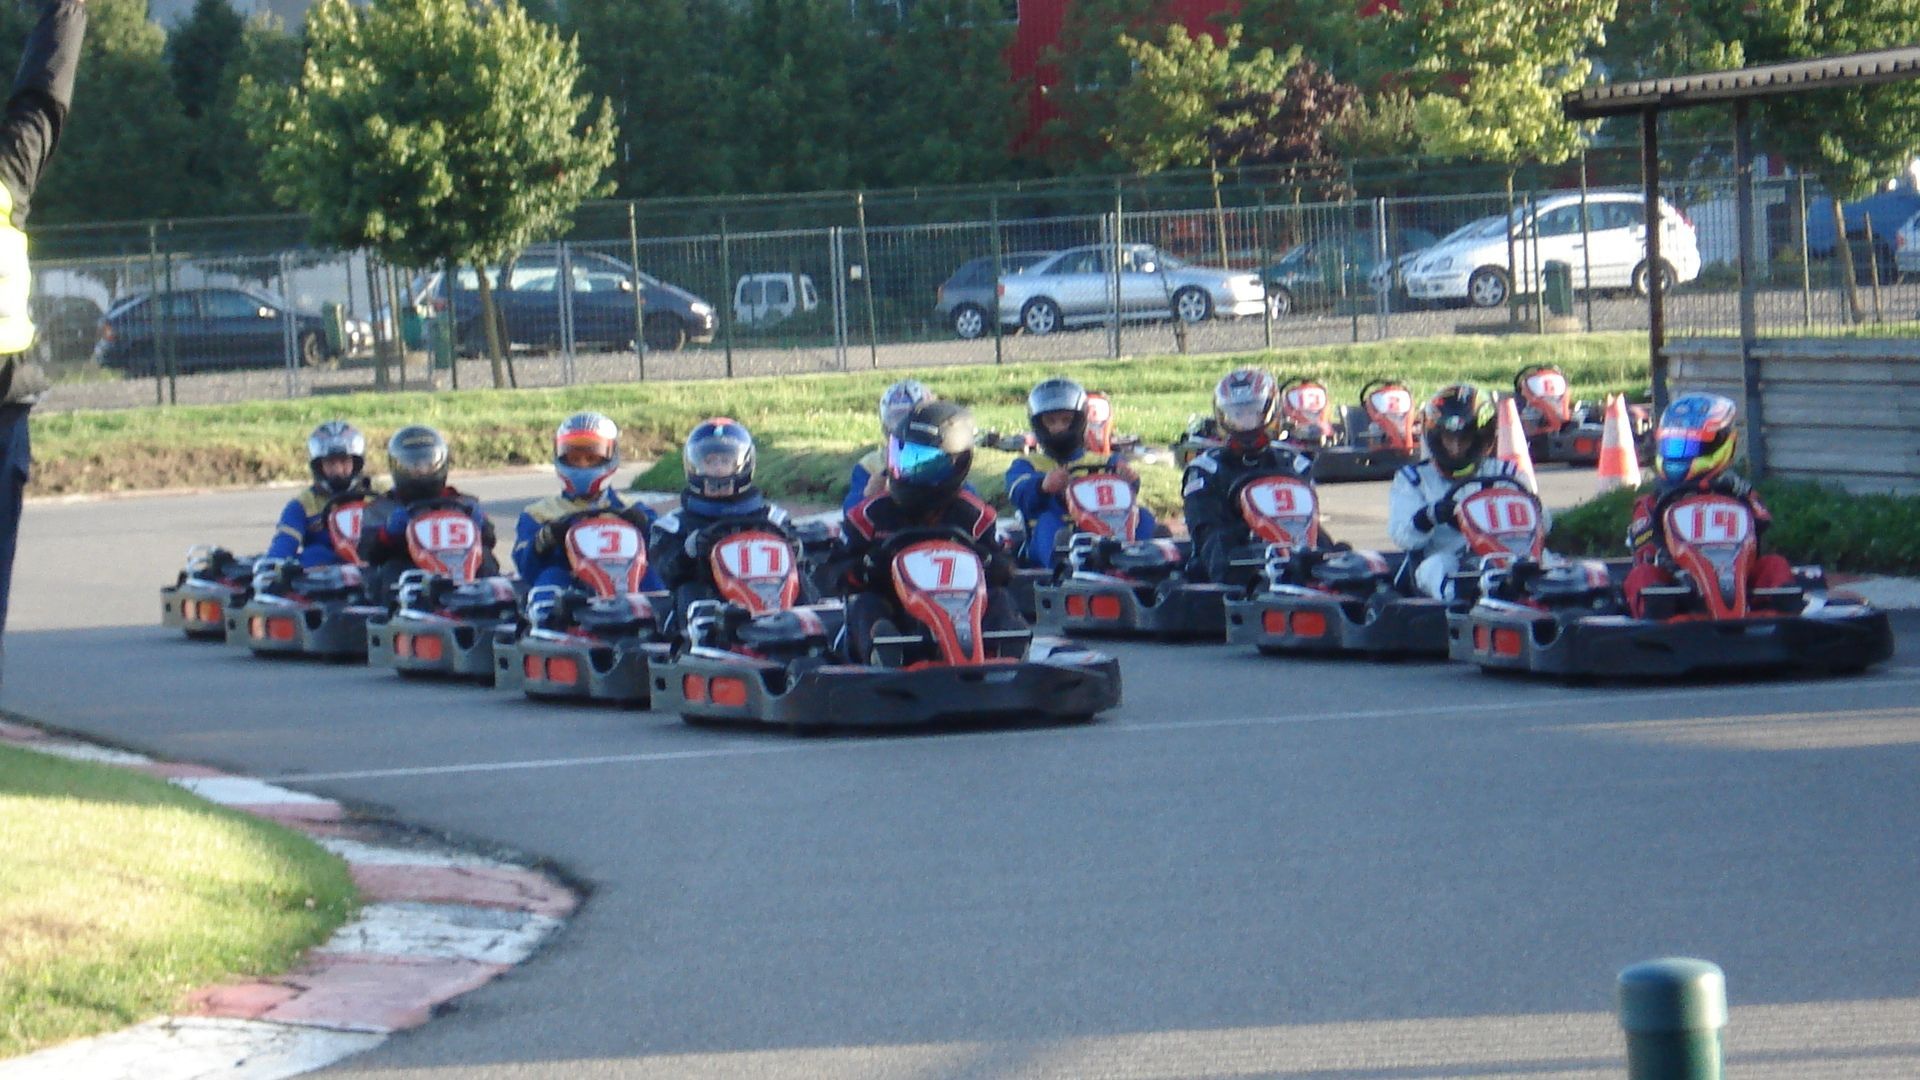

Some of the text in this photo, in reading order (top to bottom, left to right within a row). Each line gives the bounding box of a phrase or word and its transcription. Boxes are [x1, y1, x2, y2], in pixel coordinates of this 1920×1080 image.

[1097, 485, 1114, 507] 8
[1275, 488, 1296, 512] 9
[1486, 501, 1530, 529] 10
[1692, 508, 1738, 540] 14
[430, 521, 468, 546] 15
[599, 530, 622, 554] 3
[738, 546, 784, 575] 17
[932, 556, 955, 588] 7
